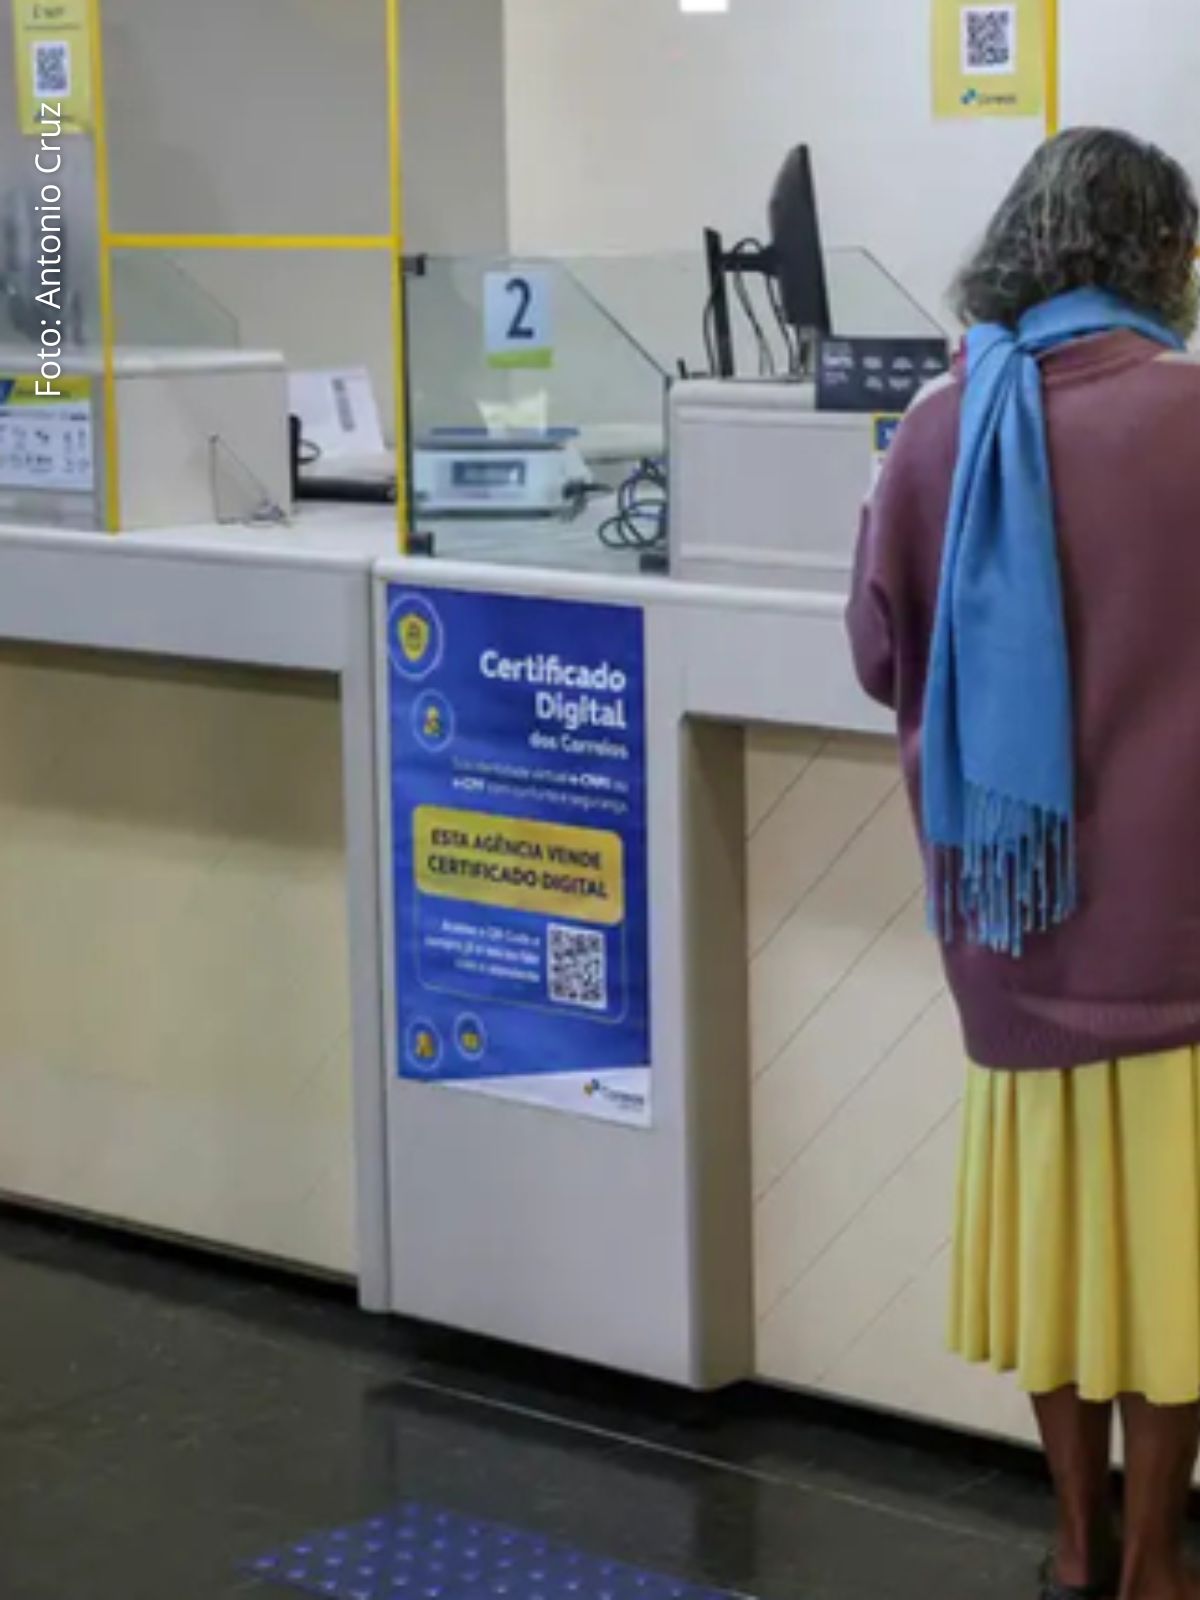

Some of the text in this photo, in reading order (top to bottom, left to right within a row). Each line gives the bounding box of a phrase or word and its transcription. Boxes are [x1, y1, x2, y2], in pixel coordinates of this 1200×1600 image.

[505, 277, 534, 340] 2
[479, 649, 627, 693] Certificado
[535, 691, 627, 731] Digital
[474, 832, 543, 859] AGÊNCIA
[427, 854, 608, 899] CERTIFICADO DIGITAL
